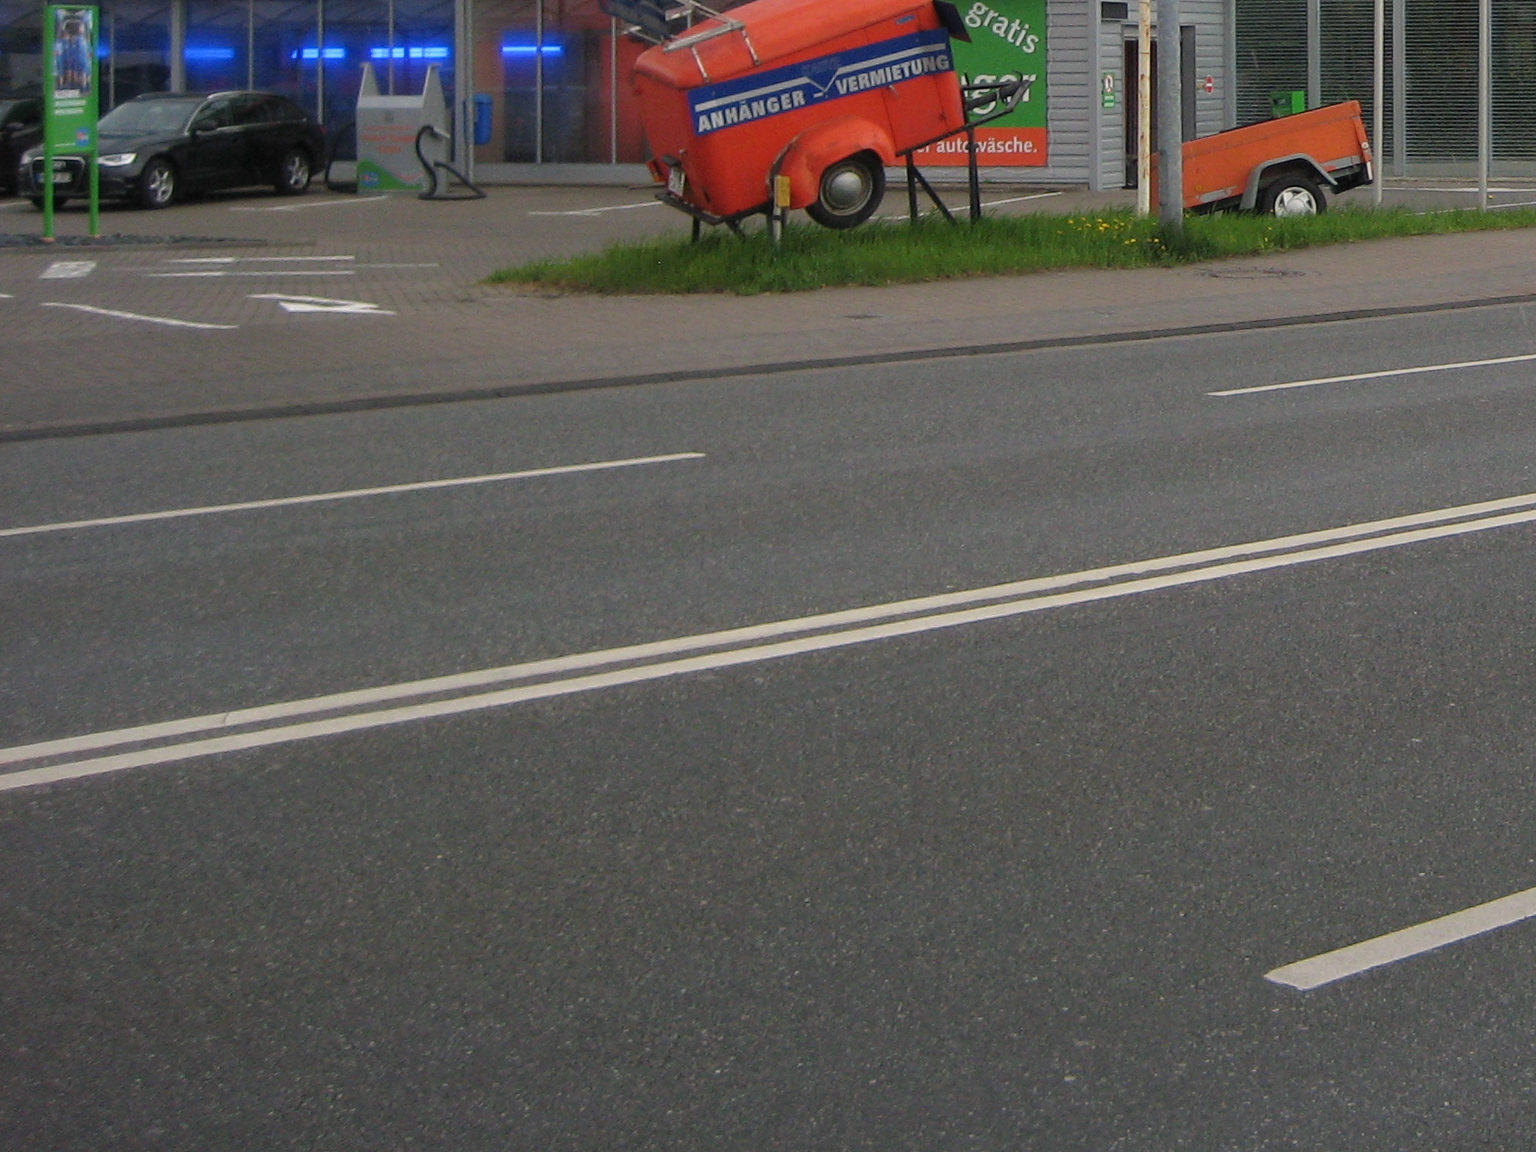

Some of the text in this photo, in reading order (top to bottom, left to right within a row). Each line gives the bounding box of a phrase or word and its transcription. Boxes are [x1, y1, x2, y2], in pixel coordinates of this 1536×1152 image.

[965, 1, 1040, 54] gratis
[697, 90, 807, 133] ANHÄNGER
[835, 54, 950, 95] VERMIETUNG
